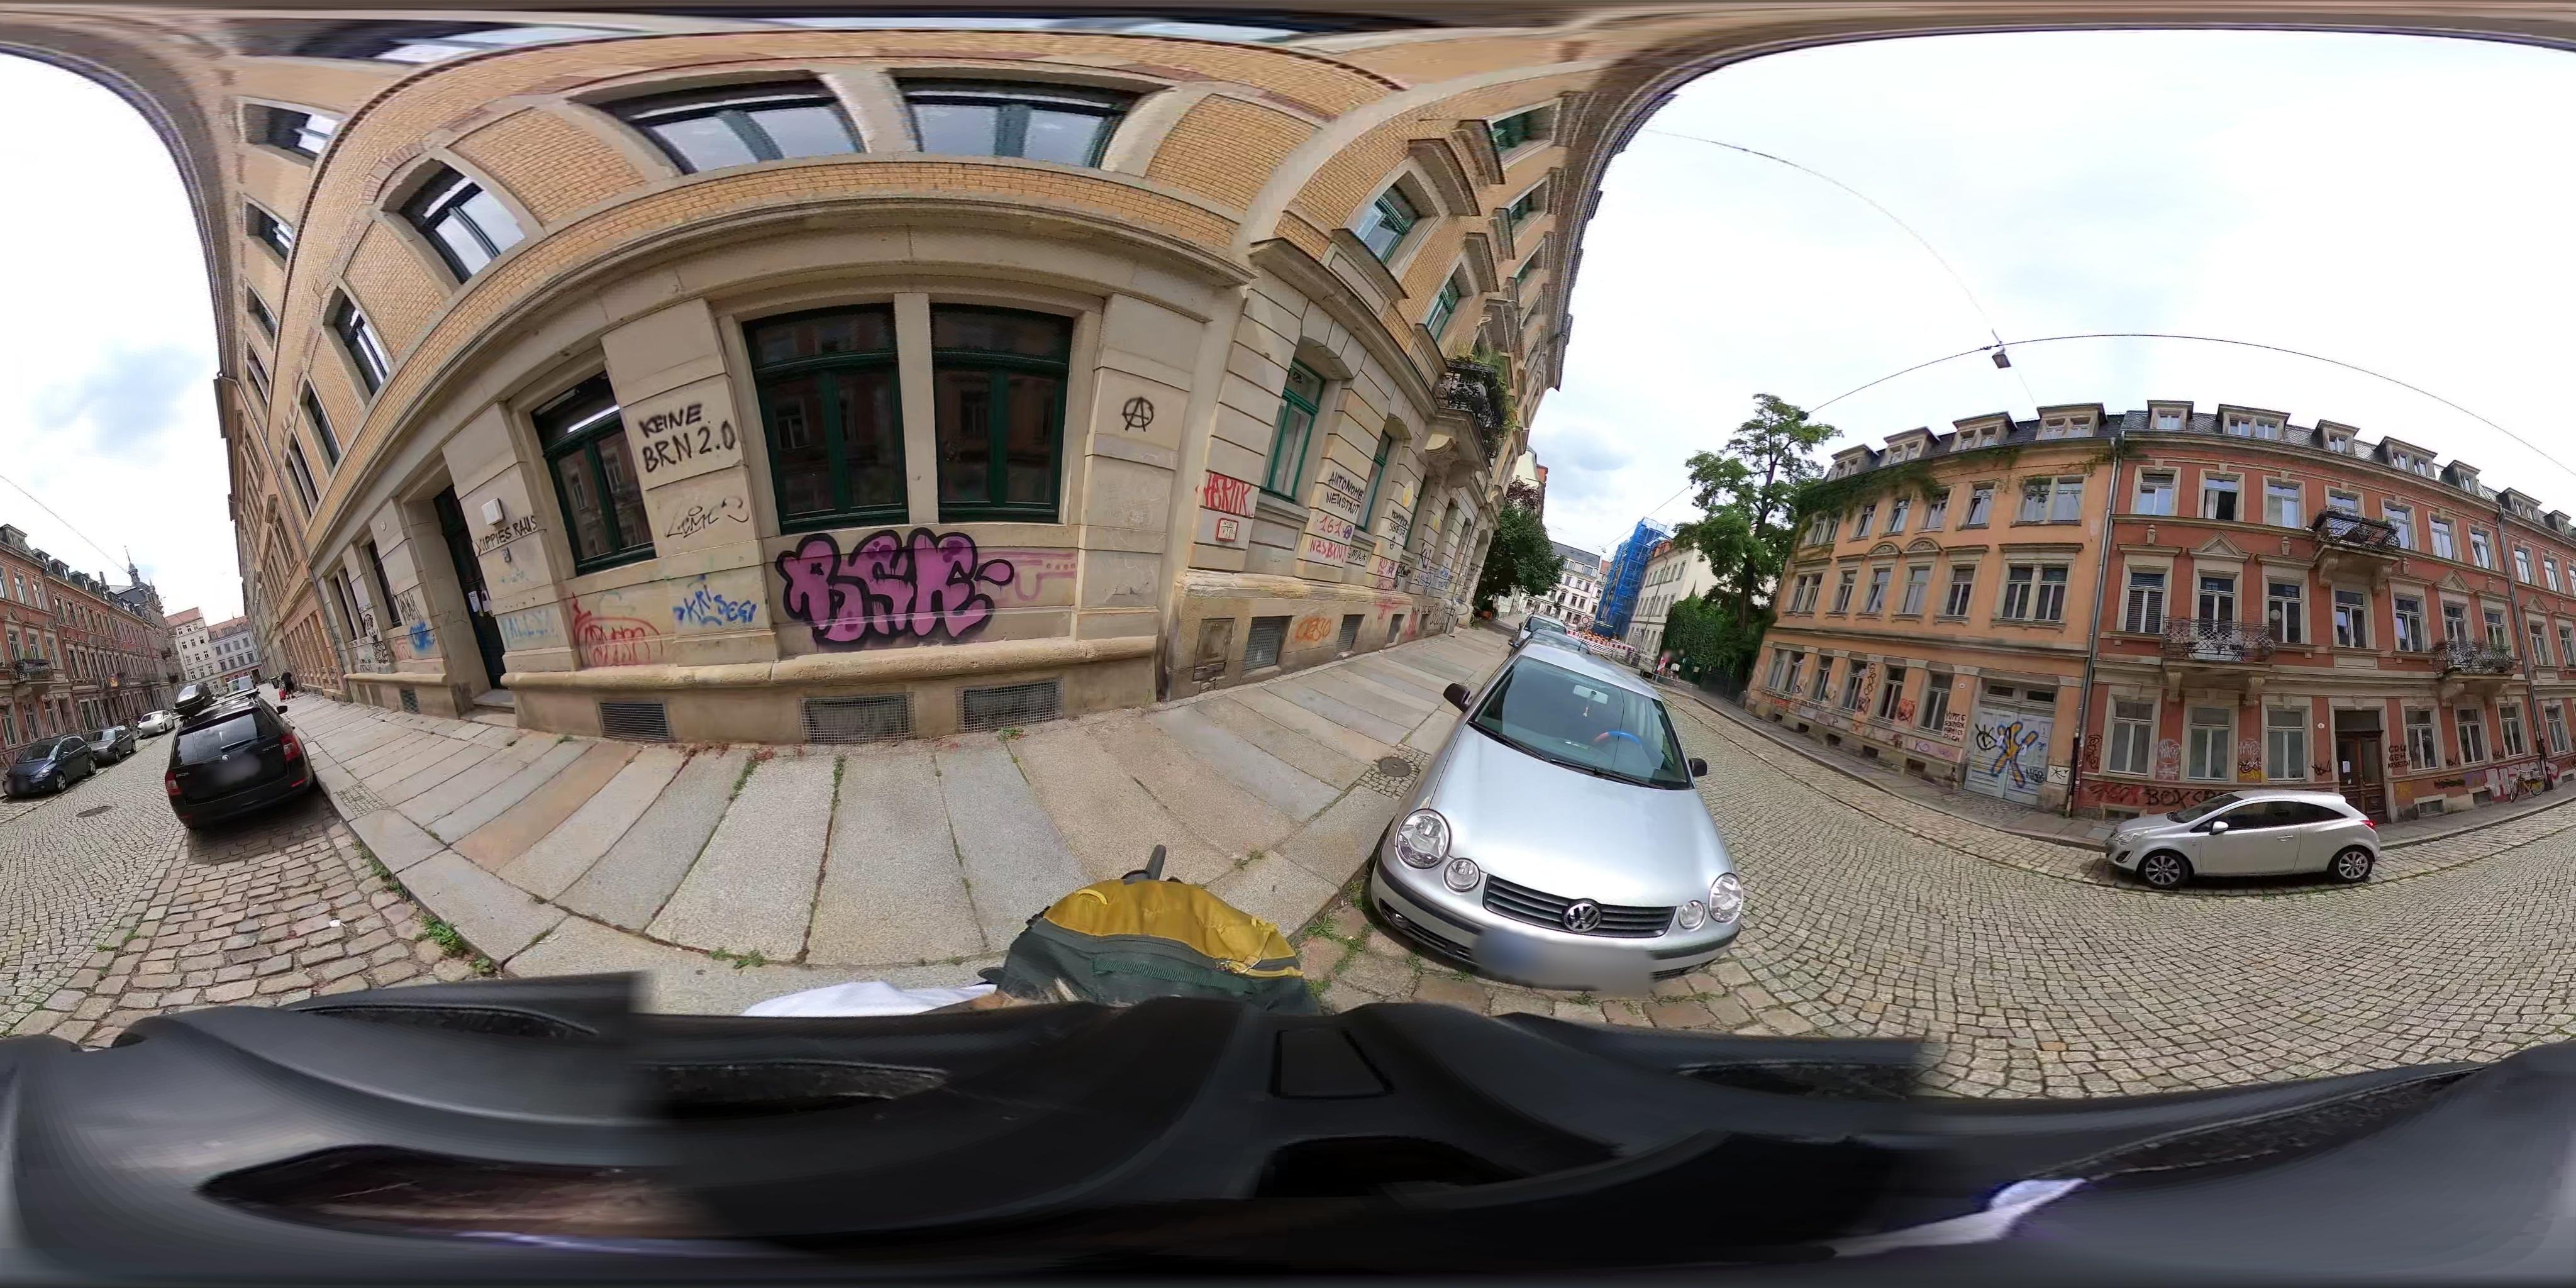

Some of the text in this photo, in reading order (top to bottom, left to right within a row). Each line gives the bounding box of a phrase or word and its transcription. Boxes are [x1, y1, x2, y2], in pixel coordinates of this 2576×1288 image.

[639, 403, 702, 438] KEINE
[642, 420, 736, 472] BRN 2.0
[1328, 471, 1364, 501] AUTONOME
[1326, 491, 1360, 516] NEUSTADT
[513, 514, 538, 536] RAUS
[1319, 515, 1343, 537] 161
[2146, 788, 2191, 809] BOX
